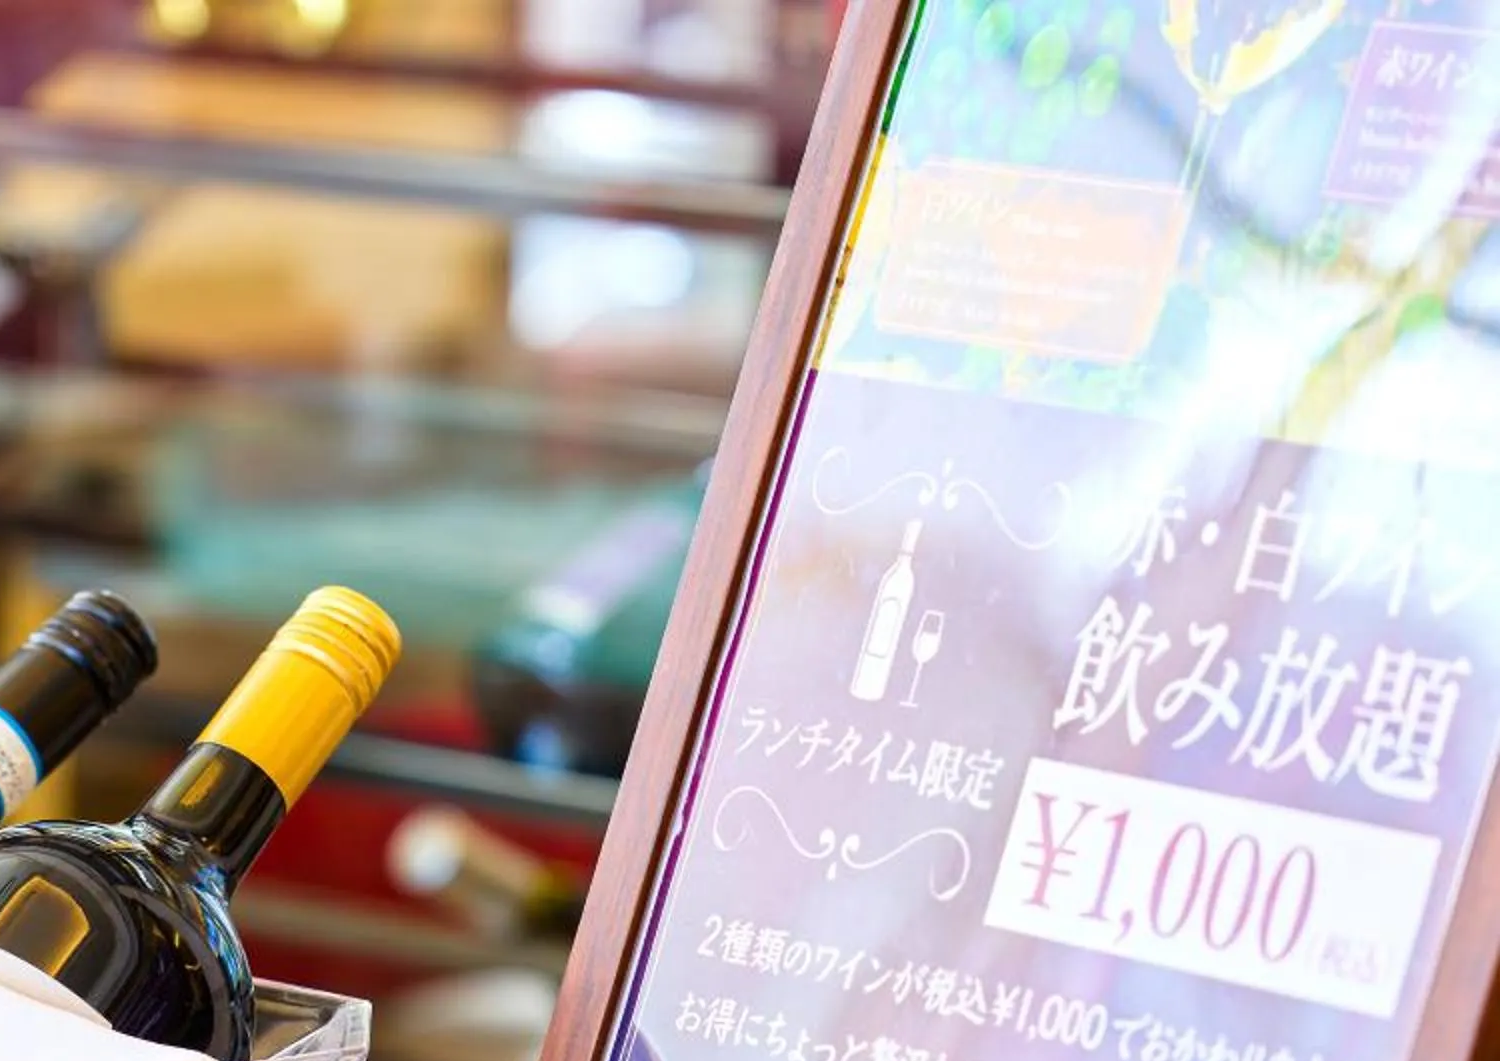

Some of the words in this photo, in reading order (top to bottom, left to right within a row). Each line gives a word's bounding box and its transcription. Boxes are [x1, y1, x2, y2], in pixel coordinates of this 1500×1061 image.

[735, 706, 1005, 811] ランチタイム限定
[1053, 596, 1472, 802] 飲み放題
[1019, 791, 1317, 964] ¥1,000
